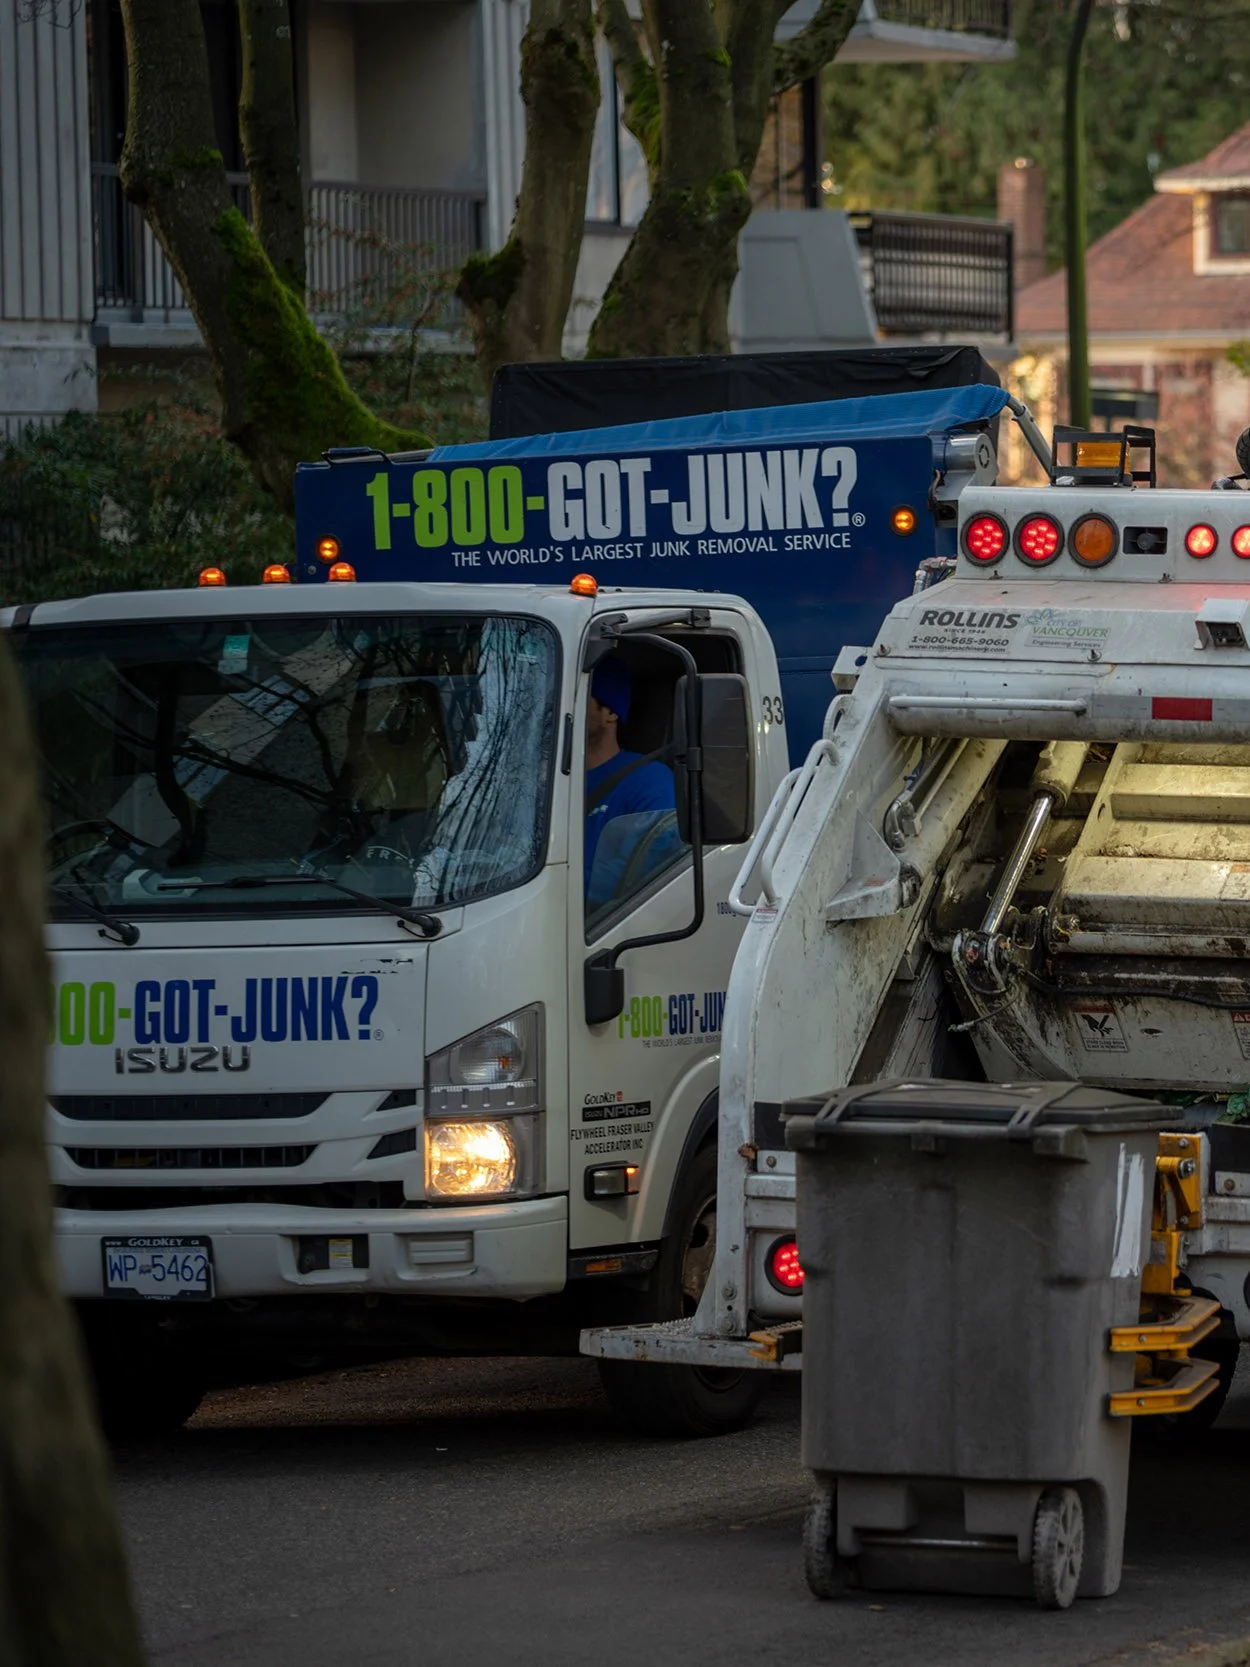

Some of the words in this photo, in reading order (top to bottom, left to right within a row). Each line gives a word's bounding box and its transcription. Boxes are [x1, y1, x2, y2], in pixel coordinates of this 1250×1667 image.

[366, 446, 858, 551] 1-800-GOT-JUNK?
[451, 552, 480, 568] THE
[487, 546, 563, 565] WORLD'S
[572, 543, 645, 562] LARGEST
[649, 540, 690, 558] JUNK
[697, 537, 777, 556] REMOVAL
[784, 533, 851, 551] SERVICE
[919, 610, 1021, 629] ROLLINS
[911, 636, 1010, 647] 1-800-665-9060
[1032, 626, 1109, 638] VANCOUVER
[1032, 639, 1071, 648] Engineering
[763, 696, 784, 725] 33
[115, 1045, 251, 1074] ISUZU
[570, 1127, 606, 1140] FLYWHEEL
[608, 1124, 632, 1136] FRASER
[633, 1121, 654, 1134] VALLEY
[584, 1139, 631, 1154] ACCELERATOR
[632, 1138, 643, 1150] INC
